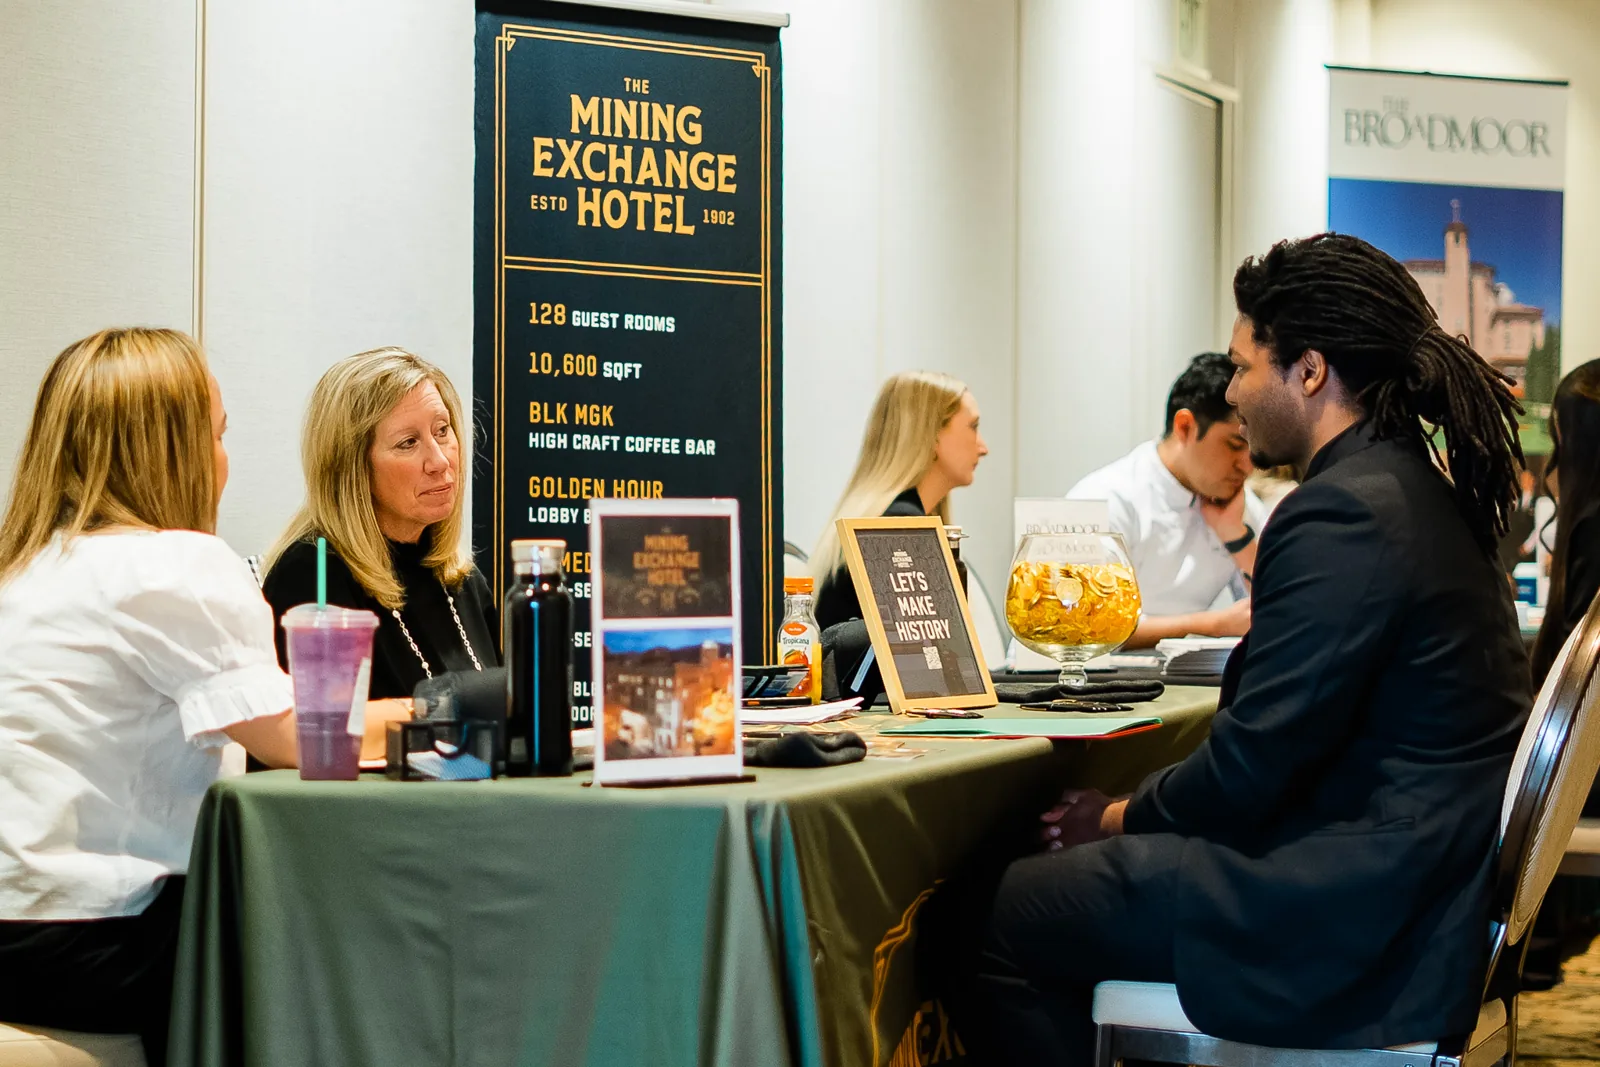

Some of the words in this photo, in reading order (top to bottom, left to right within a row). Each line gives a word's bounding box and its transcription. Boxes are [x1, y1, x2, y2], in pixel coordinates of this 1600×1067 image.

[623, 77, 650, 94] THE
[570, 94, 702, 145] MINING
[1344, 107, 1552, 157] BROADMOOR
[532, 136, 737, 194] EXCHANGE
[530, 195, 568, 212] ESTD
[577, 187, 695, 236] HOTEL
[702, 209, 735, 226] 1902
[528, 302, 567, 325] 128
[572, 310, 620, 329] GUEST
[624, 314, 676, 333] ROOMS
[528, 352, 597, 377] 10,600
[603, 361, 642, 381] SQFT
[529, 401, 568, 424] BLK
[575, 403, 614, 427] MGK
[529, 432, 568, 449] HIGH
[572, 434, 620, 451] CRAFT
[625, 436, 680, 454] COFFEE
[685, 439, 716, 455] BAR
[529, 476, 605, 499] GOLDEN
[613, 479, 664, 499] HOUR
[528, 507, 579, 524] LOBBY
[889, 571, 928, 592] LET'S
[897, 595, 937, 616] MAKE
[782, 636, 810, 645] Tropicana
[895, 619, 951, 641] HISTORY
